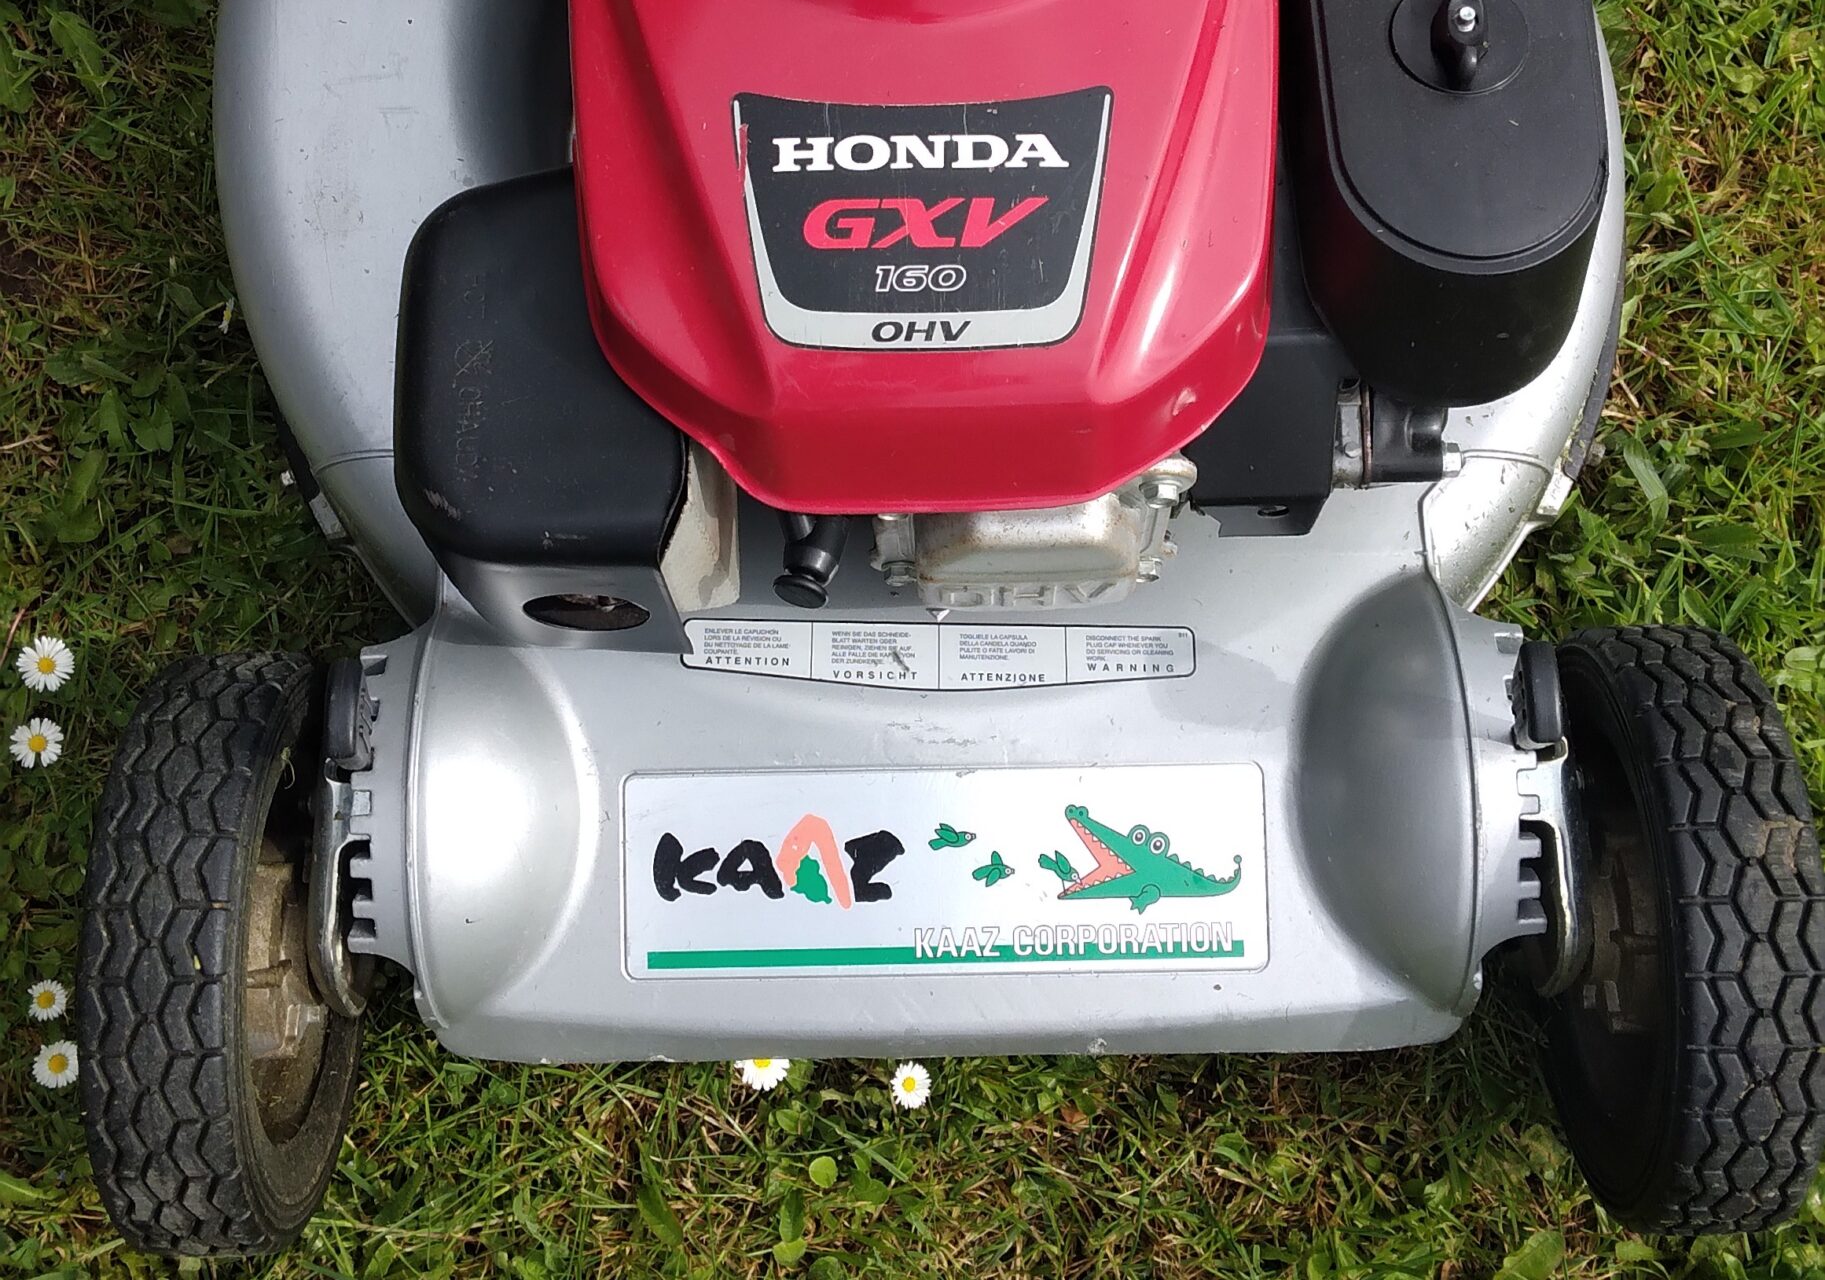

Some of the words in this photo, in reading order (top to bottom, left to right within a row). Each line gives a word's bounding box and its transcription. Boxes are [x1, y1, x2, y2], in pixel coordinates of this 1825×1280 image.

[772, 133, 1070, 173] HONDA
[802, 196, 1050, 250] GXV
[875, 263, 968, 293] 160
[871, 319, 972, 343] OHV
[705, 656, 790, 666] ATTENTION
[1087, 663, 1174, 673] WARNING
[833, 670, 918, 680] VORSICHT
[960, 672, 1045, 683] ATTENZIONE
[914, 923, 1001, 960] KAAZ
[1012, 920, 1234, 957] CORPORATION
